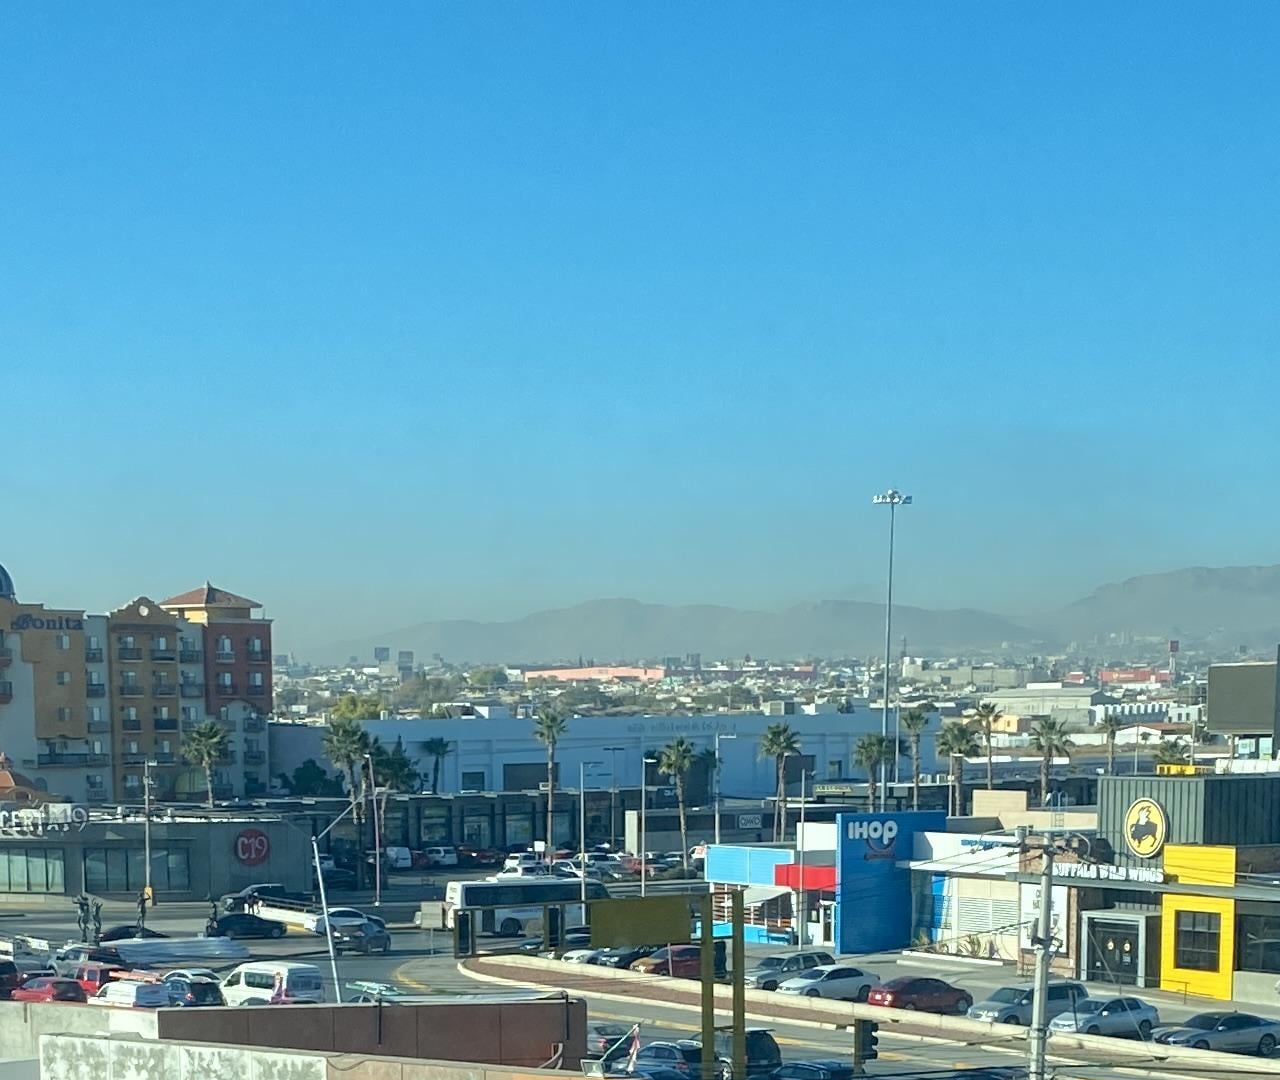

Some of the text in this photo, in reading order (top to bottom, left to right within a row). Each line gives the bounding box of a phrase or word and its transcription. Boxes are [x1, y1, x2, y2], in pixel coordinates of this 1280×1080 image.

[11, 613, 85, 631] Bonita
[847, 820, 898, 844] IHOP
[238, 836, 267, 859] C19
[1052, 863, 1164, 883] BUFFALO WILD WINGS
